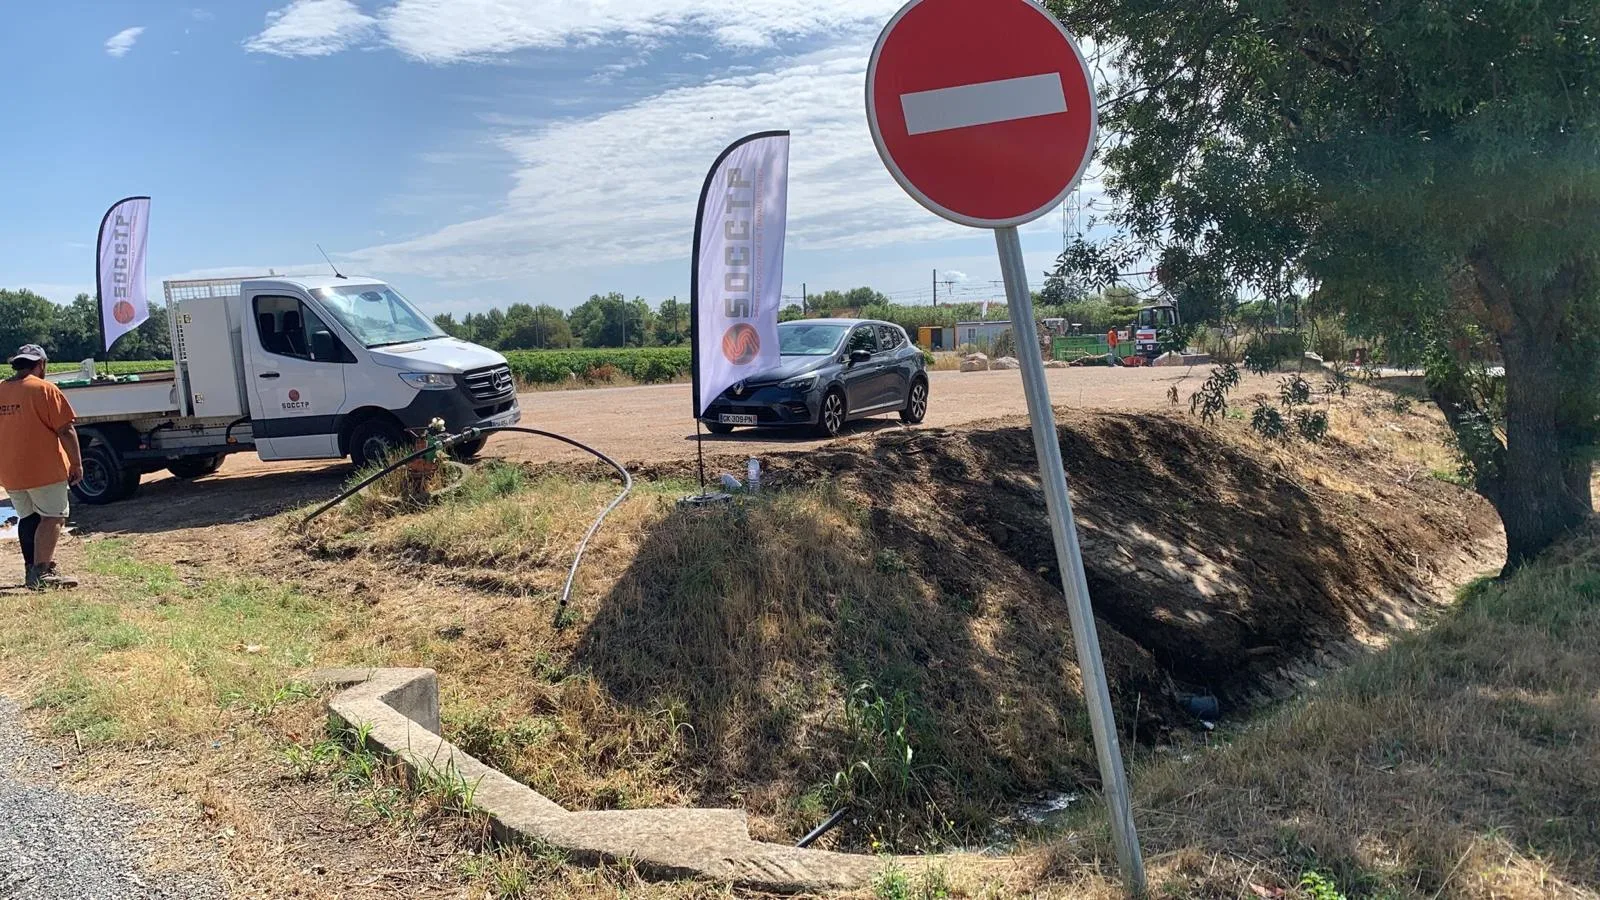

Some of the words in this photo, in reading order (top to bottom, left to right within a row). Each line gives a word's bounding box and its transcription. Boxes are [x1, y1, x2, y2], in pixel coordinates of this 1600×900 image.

[113, 215, 129, 298] SOCCTP
[724, 167, 751, 318] SOCCTP
[281, 401, 309, 409] SOCCTP
